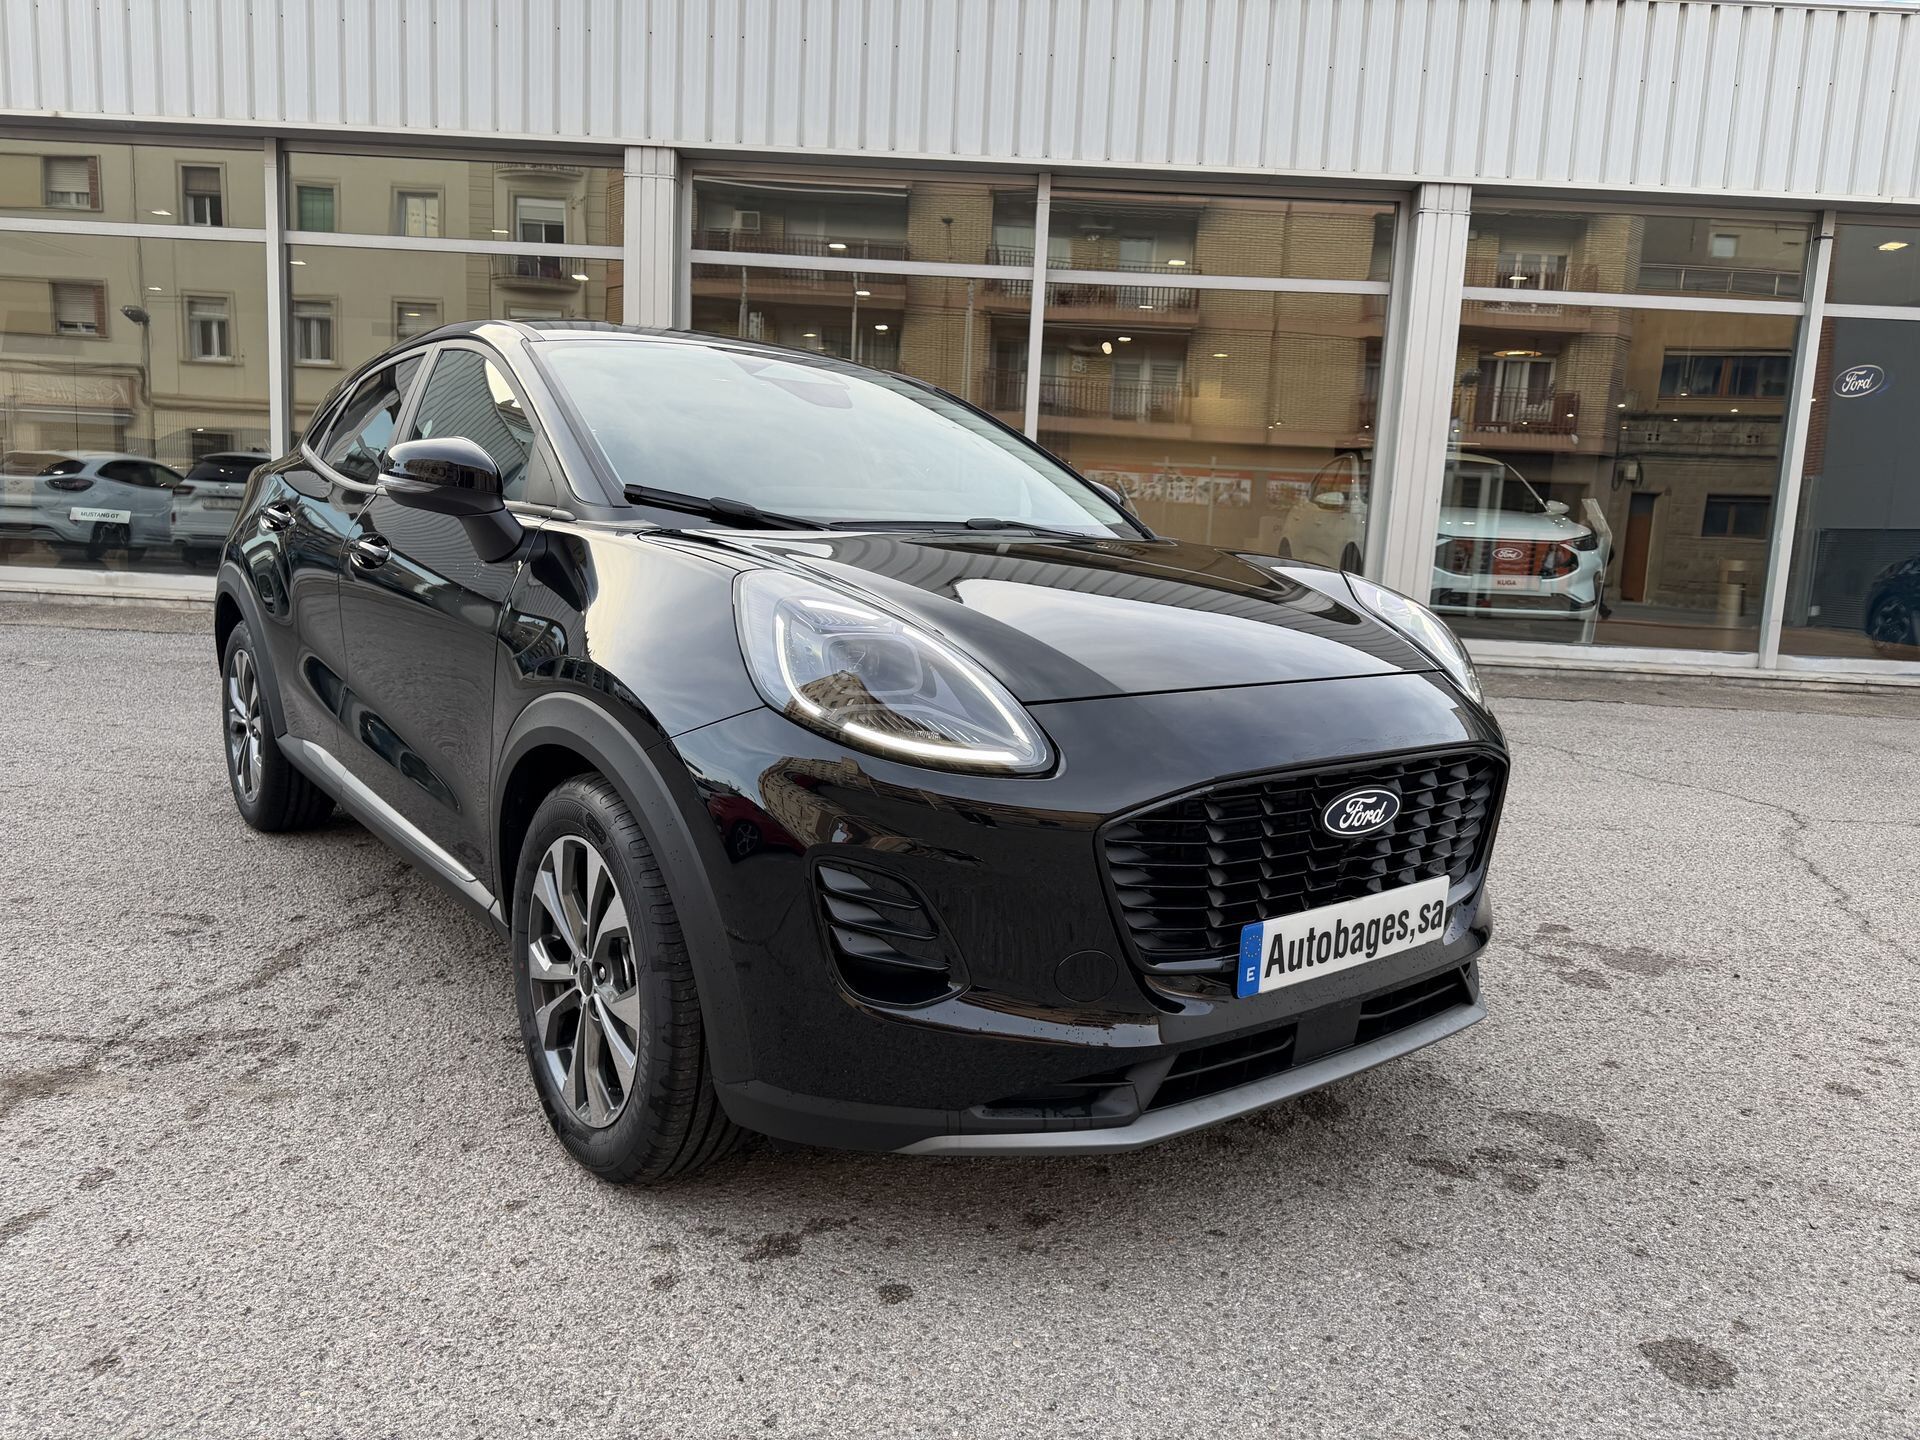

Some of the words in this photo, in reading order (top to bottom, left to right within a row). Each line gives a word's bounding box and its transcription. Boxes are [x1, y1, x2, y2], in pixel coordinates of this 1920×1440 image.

[1841, 369, 1872, 393] Ford
[80, 511, 110, 519] MUSTANG
[110, 512, 120, 520] GT
[1496, 579, 1518, 587] KUGA
[1339, 797, 1384, 828] Ford
[1246, 966, 1255, 982] E
